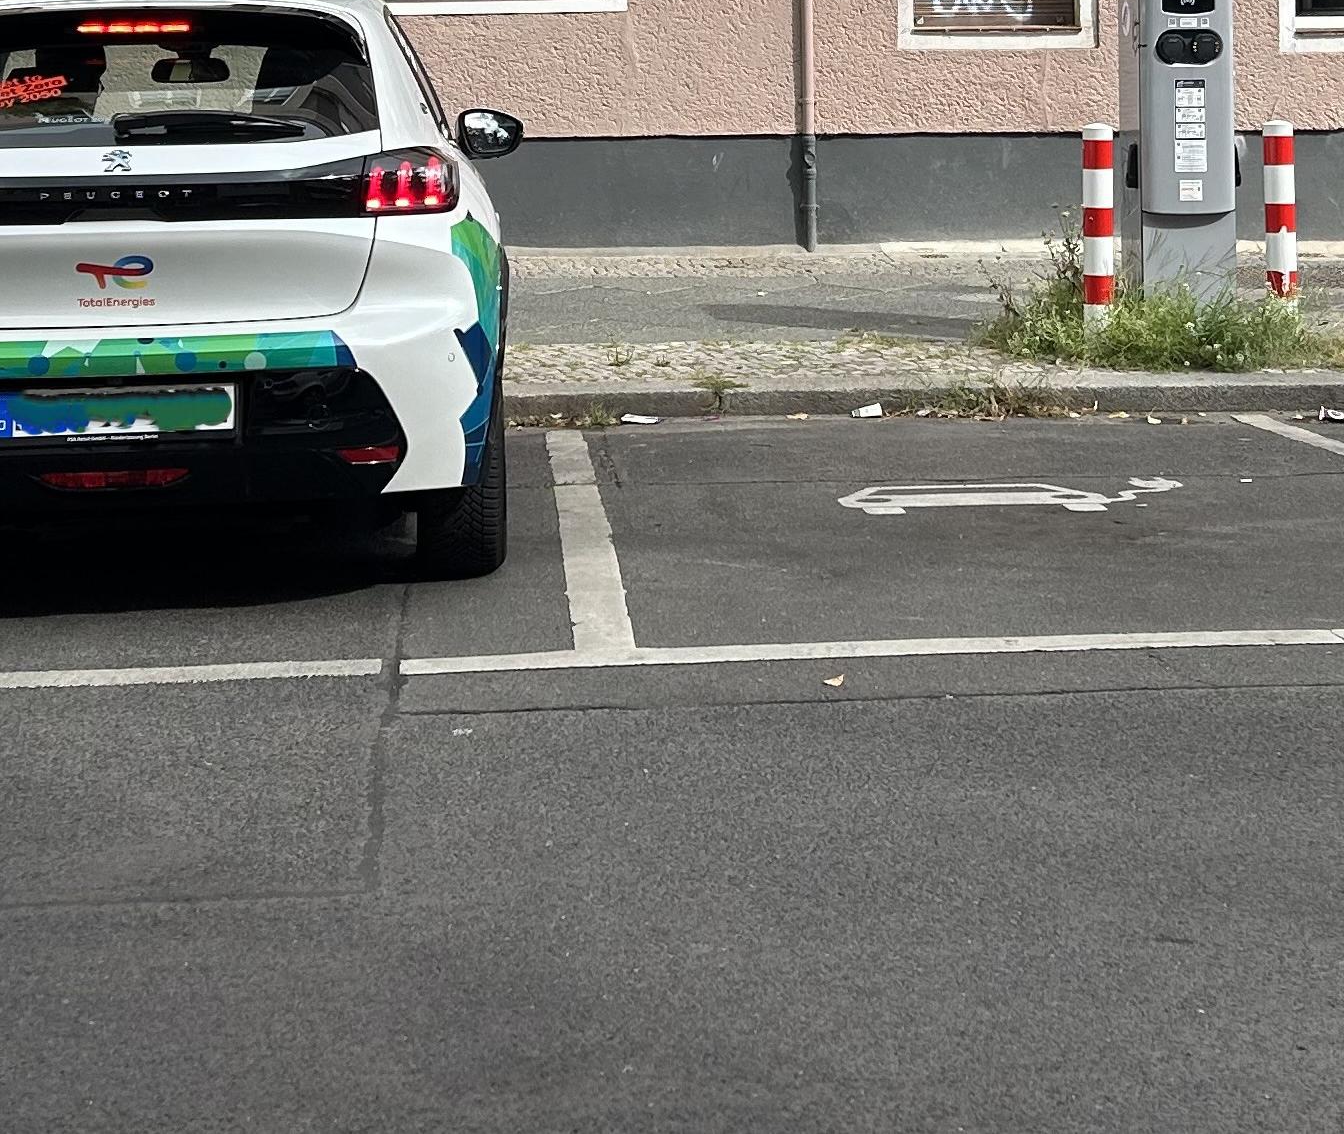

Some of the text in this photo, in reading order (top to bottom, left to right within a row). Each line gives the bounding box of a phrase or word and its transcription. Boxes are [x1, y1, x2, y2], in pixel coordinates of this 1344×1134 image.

[20, 88, 62, 103] 2050
[40, 189, 192, 200] PEUGEOT
[77, 297, 156, 308] TotalEnergies
